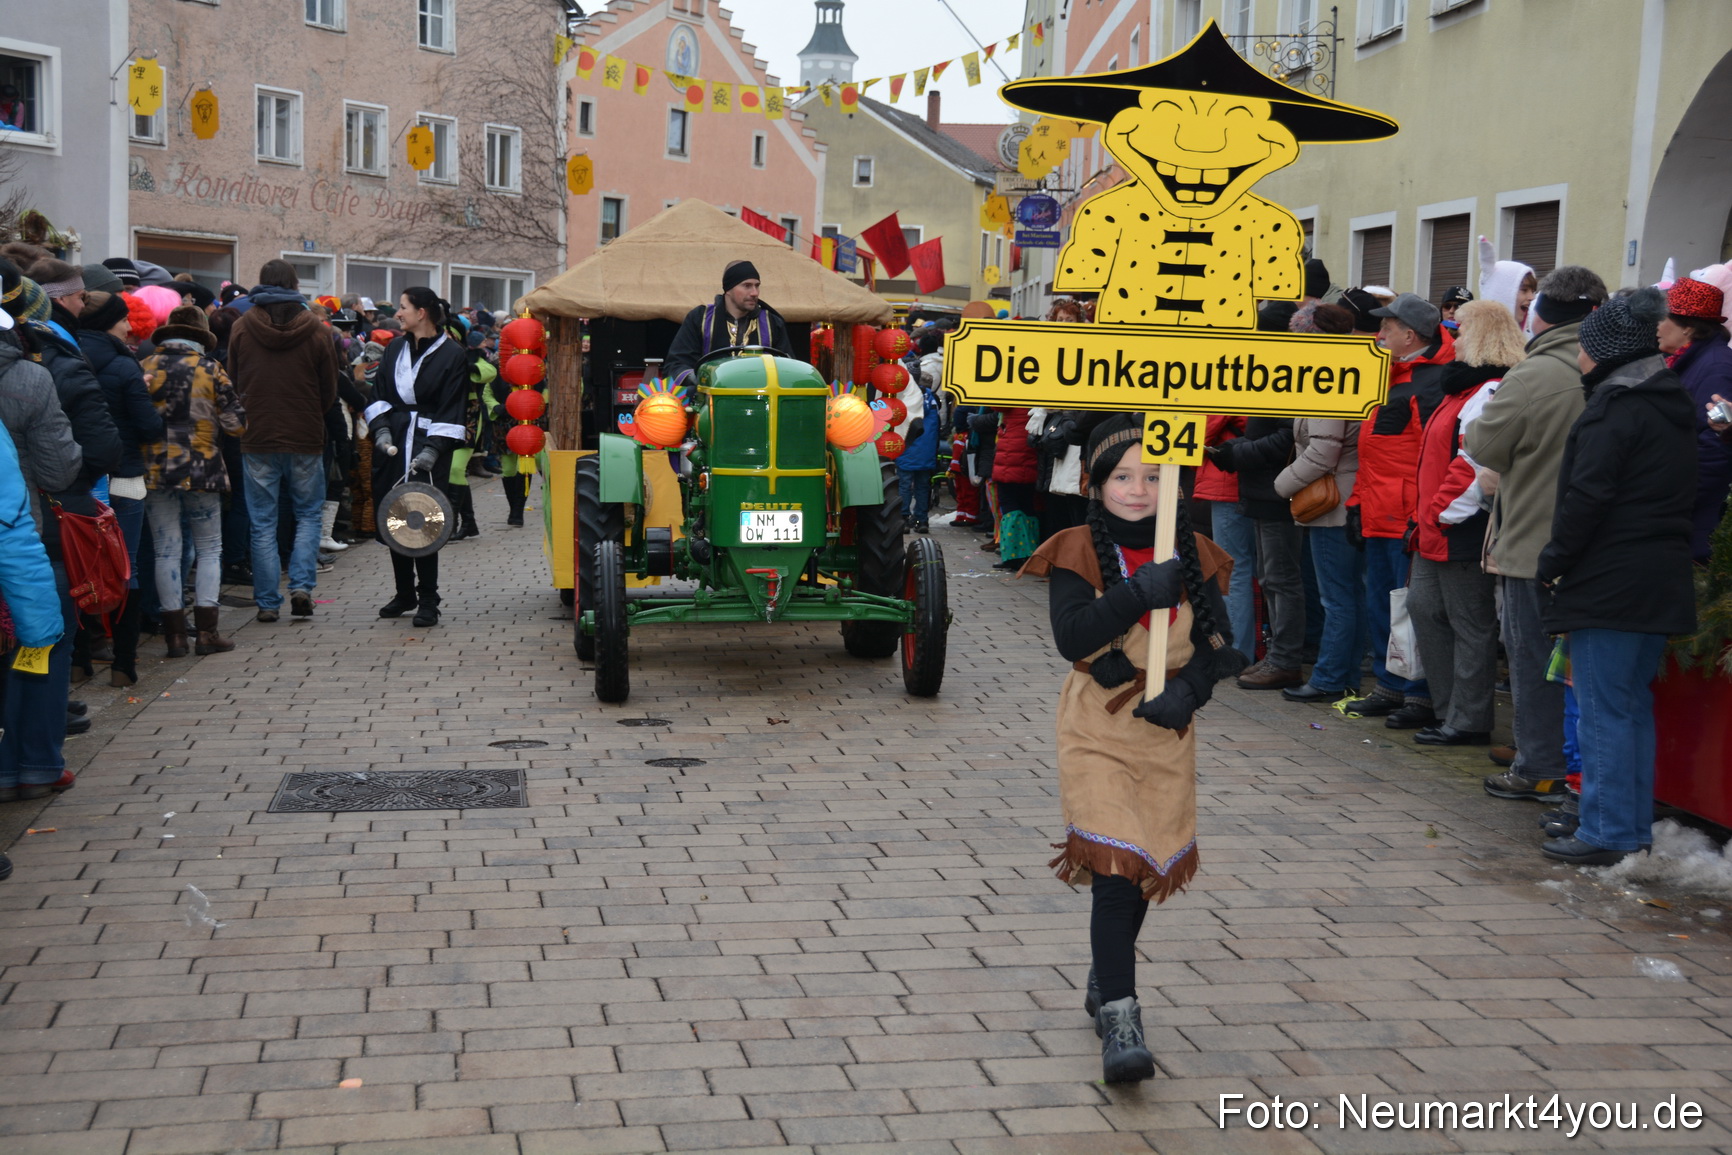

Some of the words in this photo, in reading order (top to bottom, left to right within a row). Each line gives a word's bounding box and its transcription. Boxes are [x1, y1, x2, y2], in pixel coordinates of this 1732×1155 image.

[174, 161, 299, 209] Konditorei
[311, 178, 360, 217] Cafe
[974, 343, 1040, 385] Die
[1056, 347, 1361, 398] Unkaputtbaren
[1145, 419, 1198, 457] 34
[740, 502, 803, 510] DEUTZ
[756, 514, 775, 527] NM
[774, 528, 800, 541] 111
